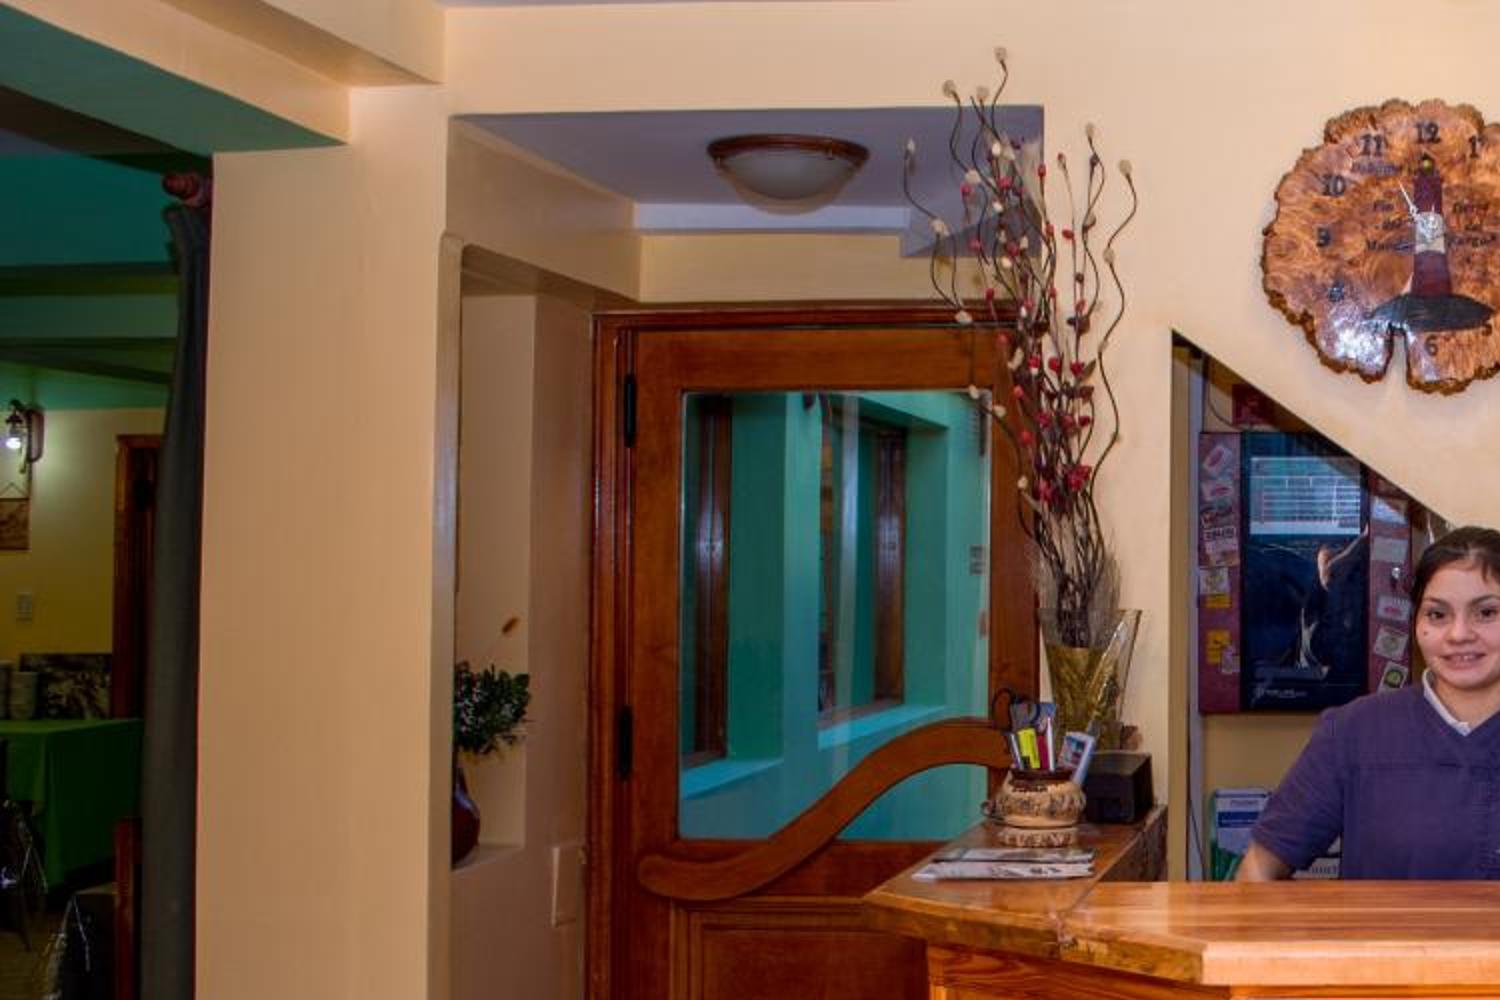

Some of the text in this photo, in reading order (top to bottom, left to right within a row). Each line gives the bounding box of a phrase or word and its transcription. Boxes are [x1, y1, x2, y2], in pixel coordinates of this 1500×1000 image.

[1359, 132, 1385, 157] 11
[1415, 121, 1441, 144] 12
[1468, 135, 1479, 159] 1
[1321, 173, 1346, 197] 10
[1316, 225, 1331, 249] 9
[1425, 335, 1439, 358] 6
